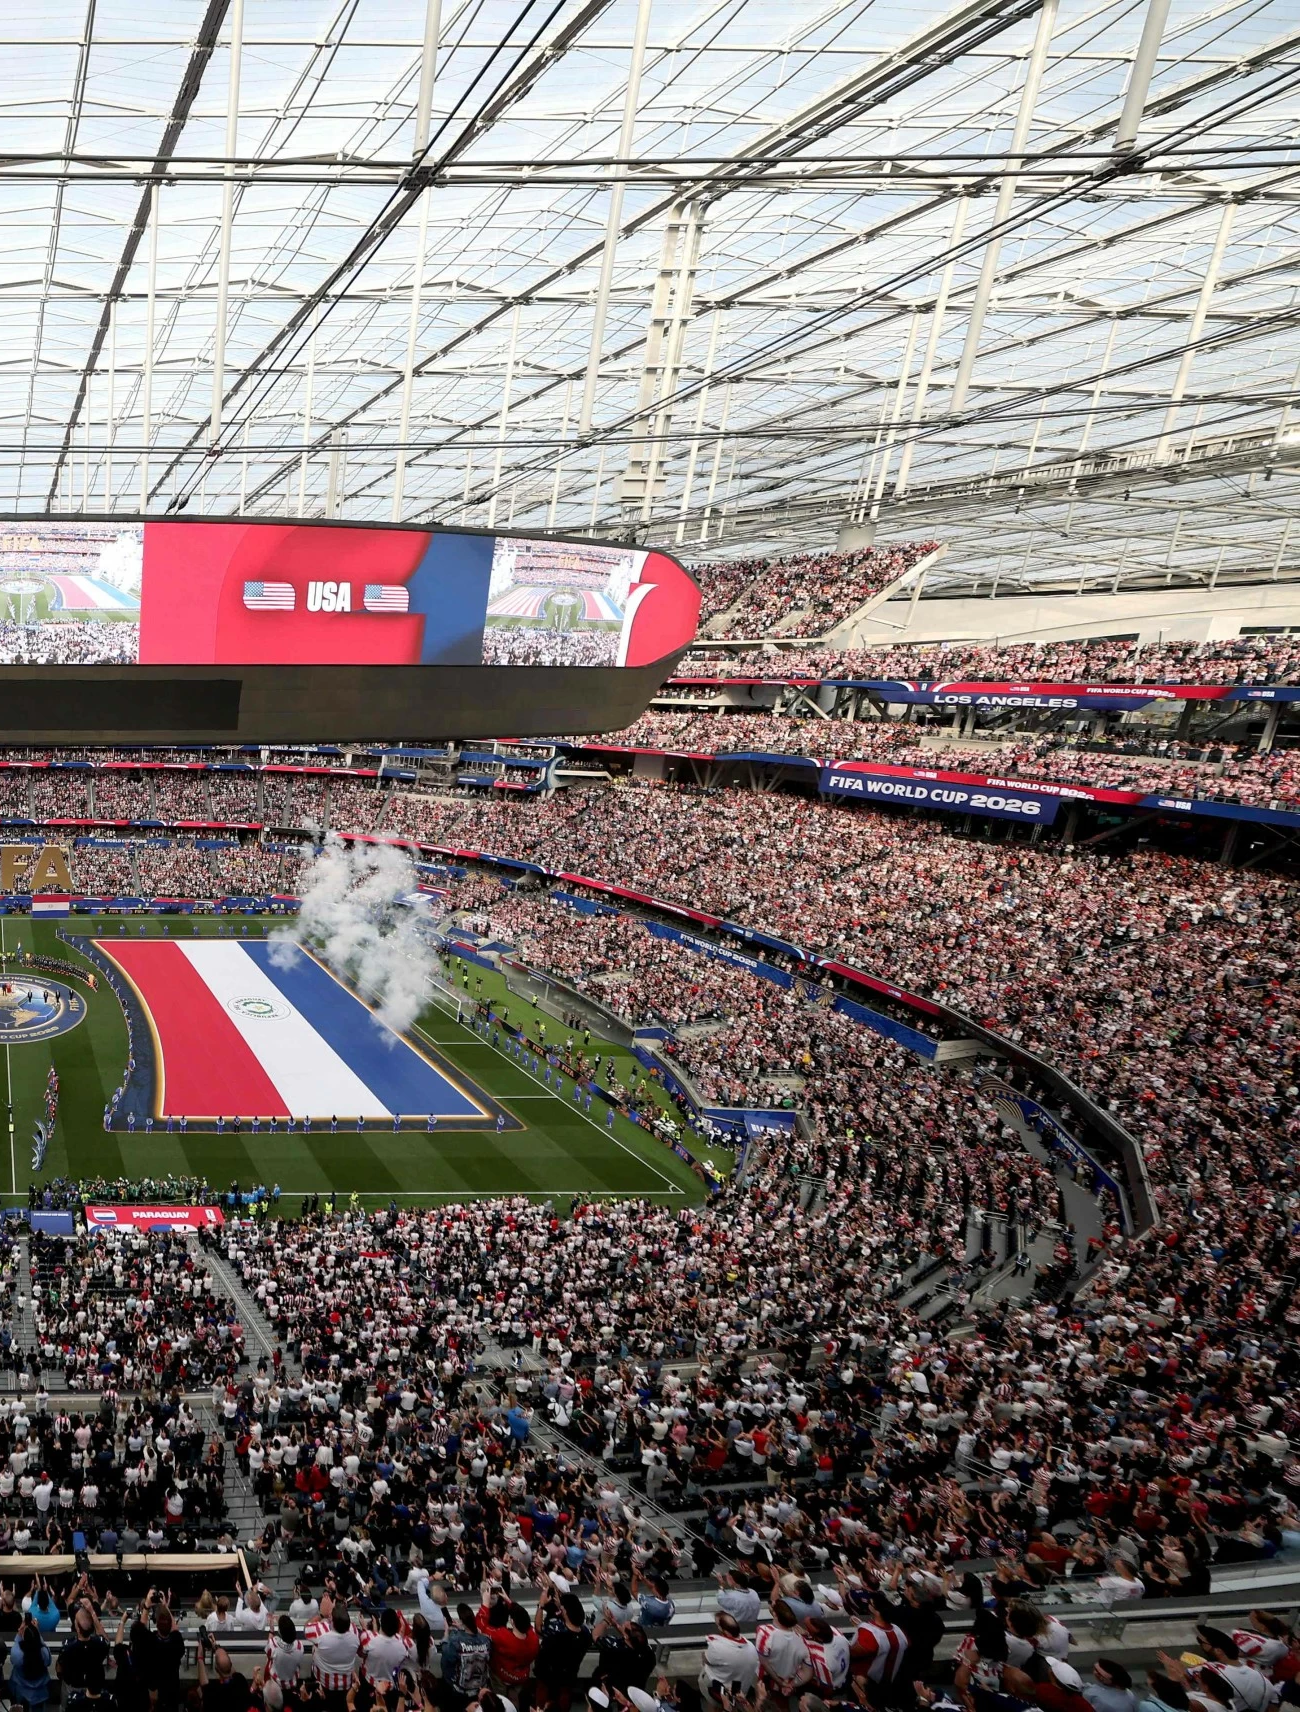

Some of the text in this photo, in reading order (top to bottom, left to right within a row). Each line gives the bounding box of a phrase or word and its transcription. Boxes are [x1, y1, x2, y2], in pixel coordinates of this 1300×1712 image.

[307, 581, 351, 613] USA
[934, 695, 1077, 708] LOS ANGELES
[986, 778, 1006, 786] FIFA
[1006, 780, 1039, 791] WORLD
[1040, 785, 1060, 793] CUP
[829, 776, 1041, 815] FIFA WORLD CUP 2026
[694, 939, 718, 952] WORLD
[718, 948, 732, 957] CUP
[732, 953, 757, 968] 2026
[635, 1114, 651, 1131] FIFA
[132, 1211, 189, 1219] PARAGUAY
